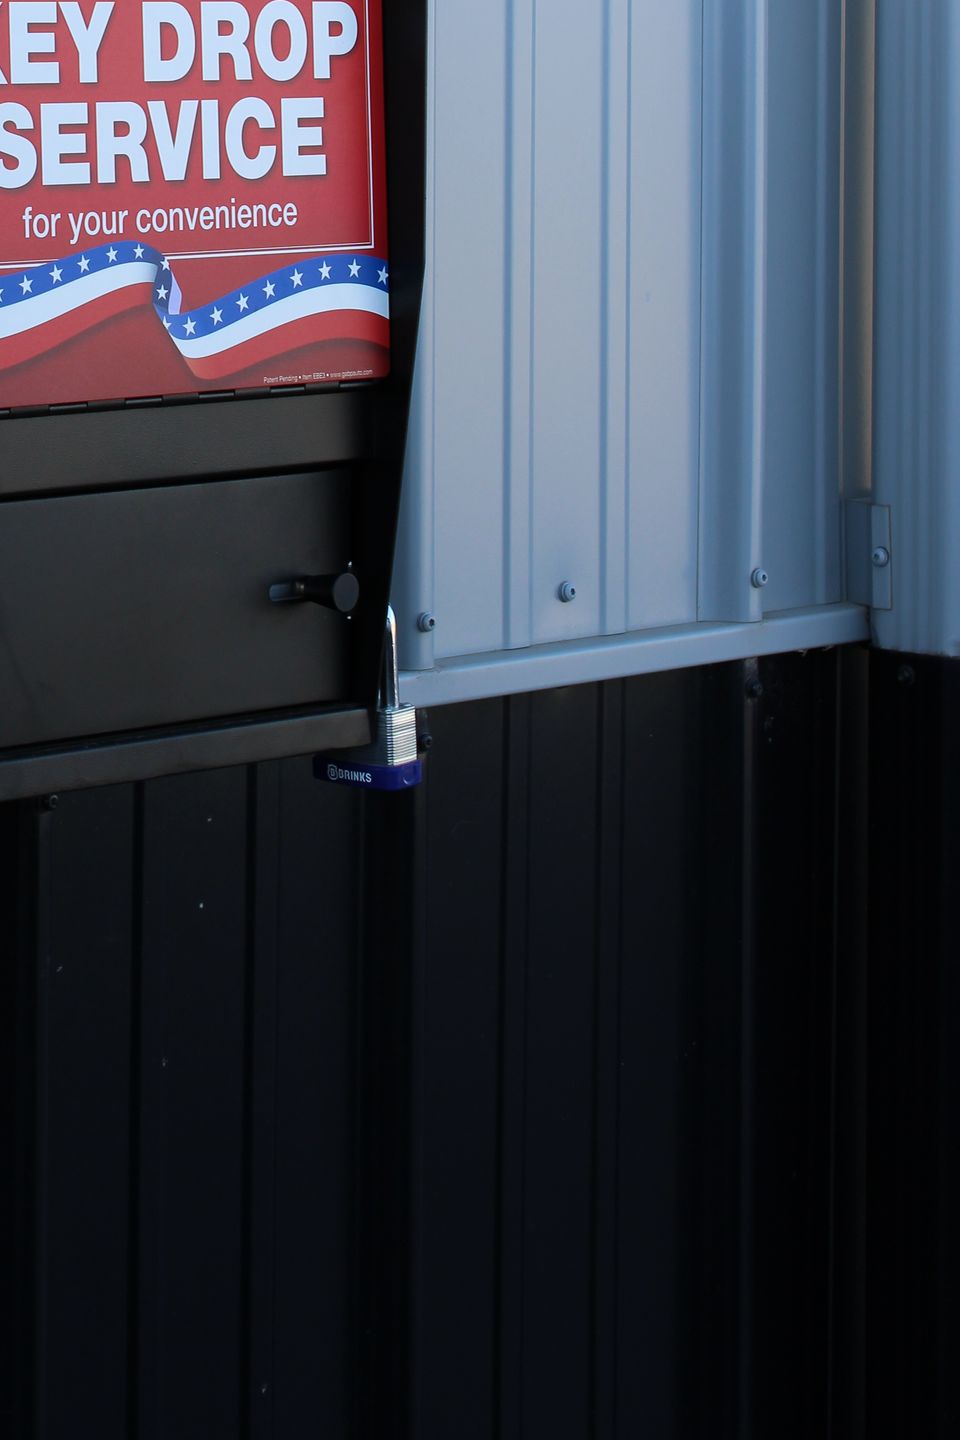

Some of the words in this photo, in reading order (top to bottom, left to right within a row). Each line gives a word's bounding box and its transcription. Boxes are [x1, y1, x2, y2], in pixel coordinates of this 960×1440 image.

[22, 205, 61, 238] for
[68, 208, 129, 245] your
[135, 198, 298, 233] convenience
[338, 767, 372, 783] BRINKS
